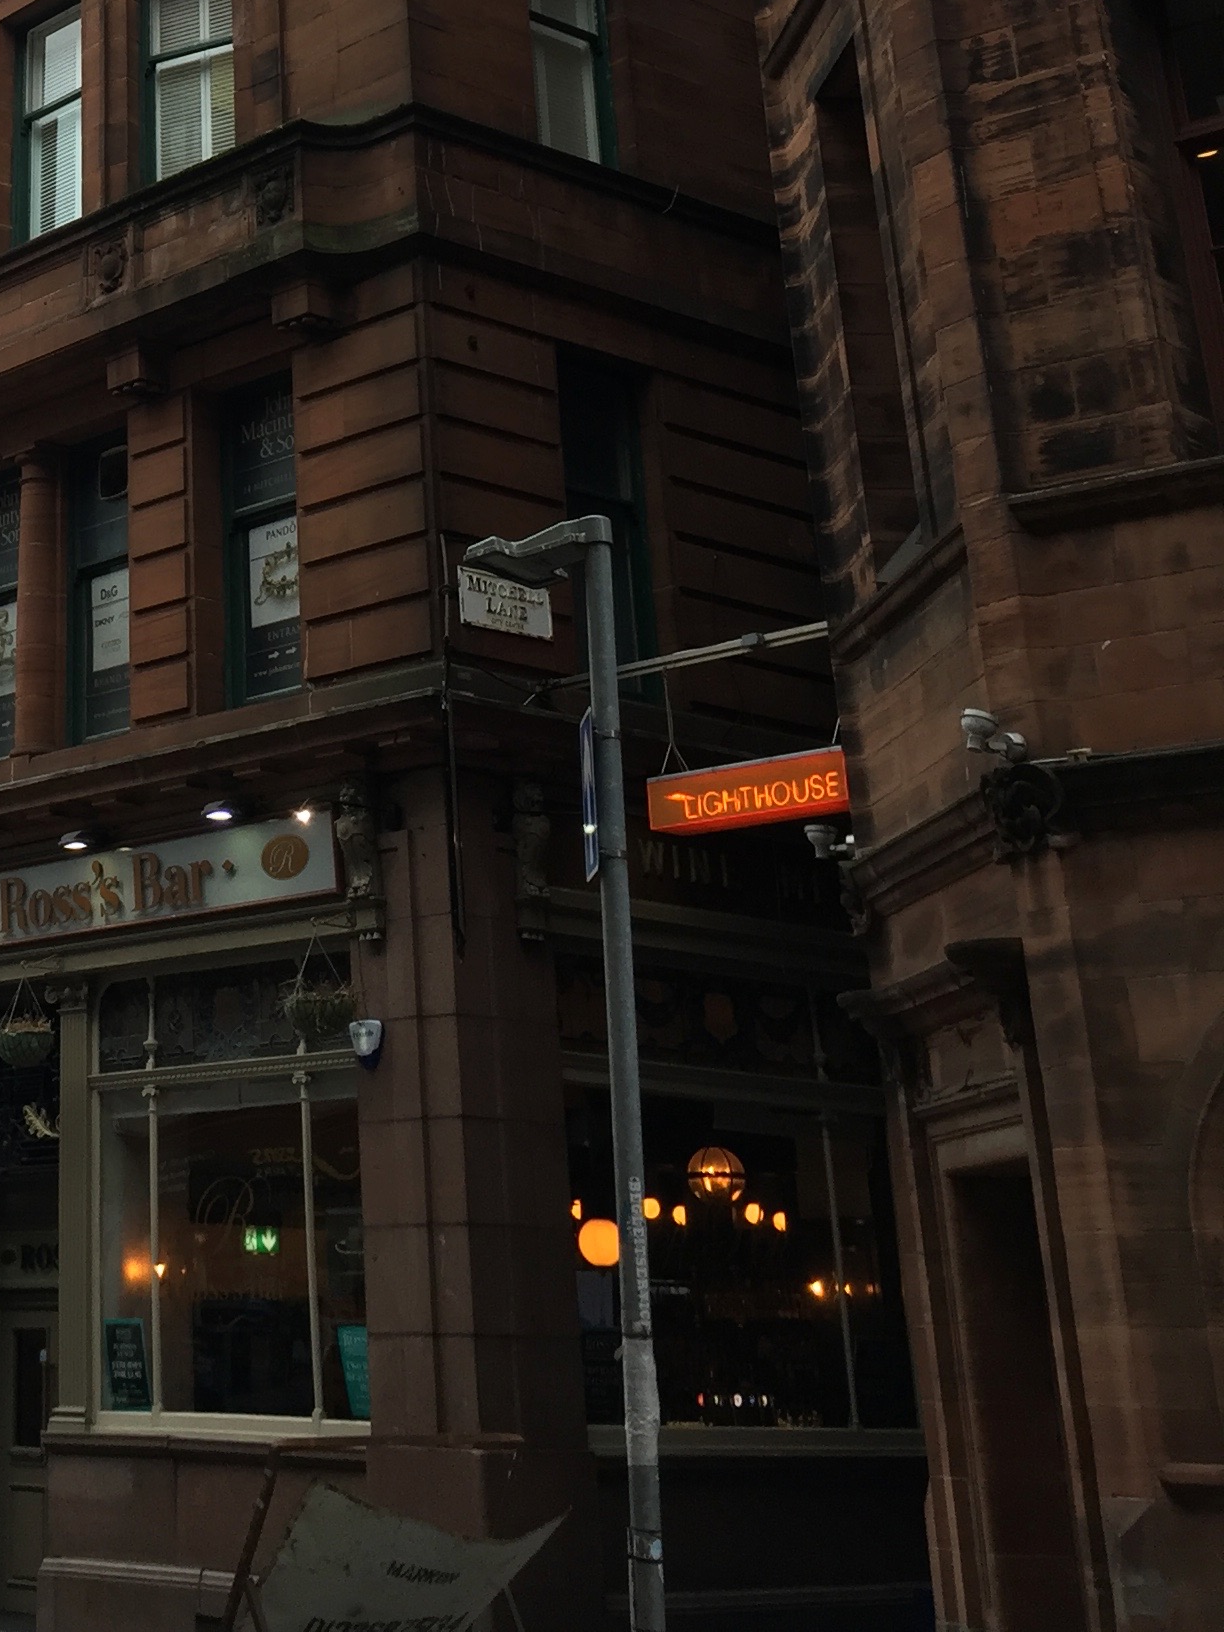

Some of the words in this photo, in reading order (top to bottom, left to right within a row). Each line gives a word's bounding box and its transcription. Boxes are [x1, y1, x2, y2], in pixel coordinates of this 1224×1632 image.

[260, 437, 274, 459] &
[467, 574, 544, 606] MITCHELL
[486, 596, 528, 621] LANE
[684, 771, 839, 820] LIGHTHOUSE
[131, 851, 216, 914] Bar
